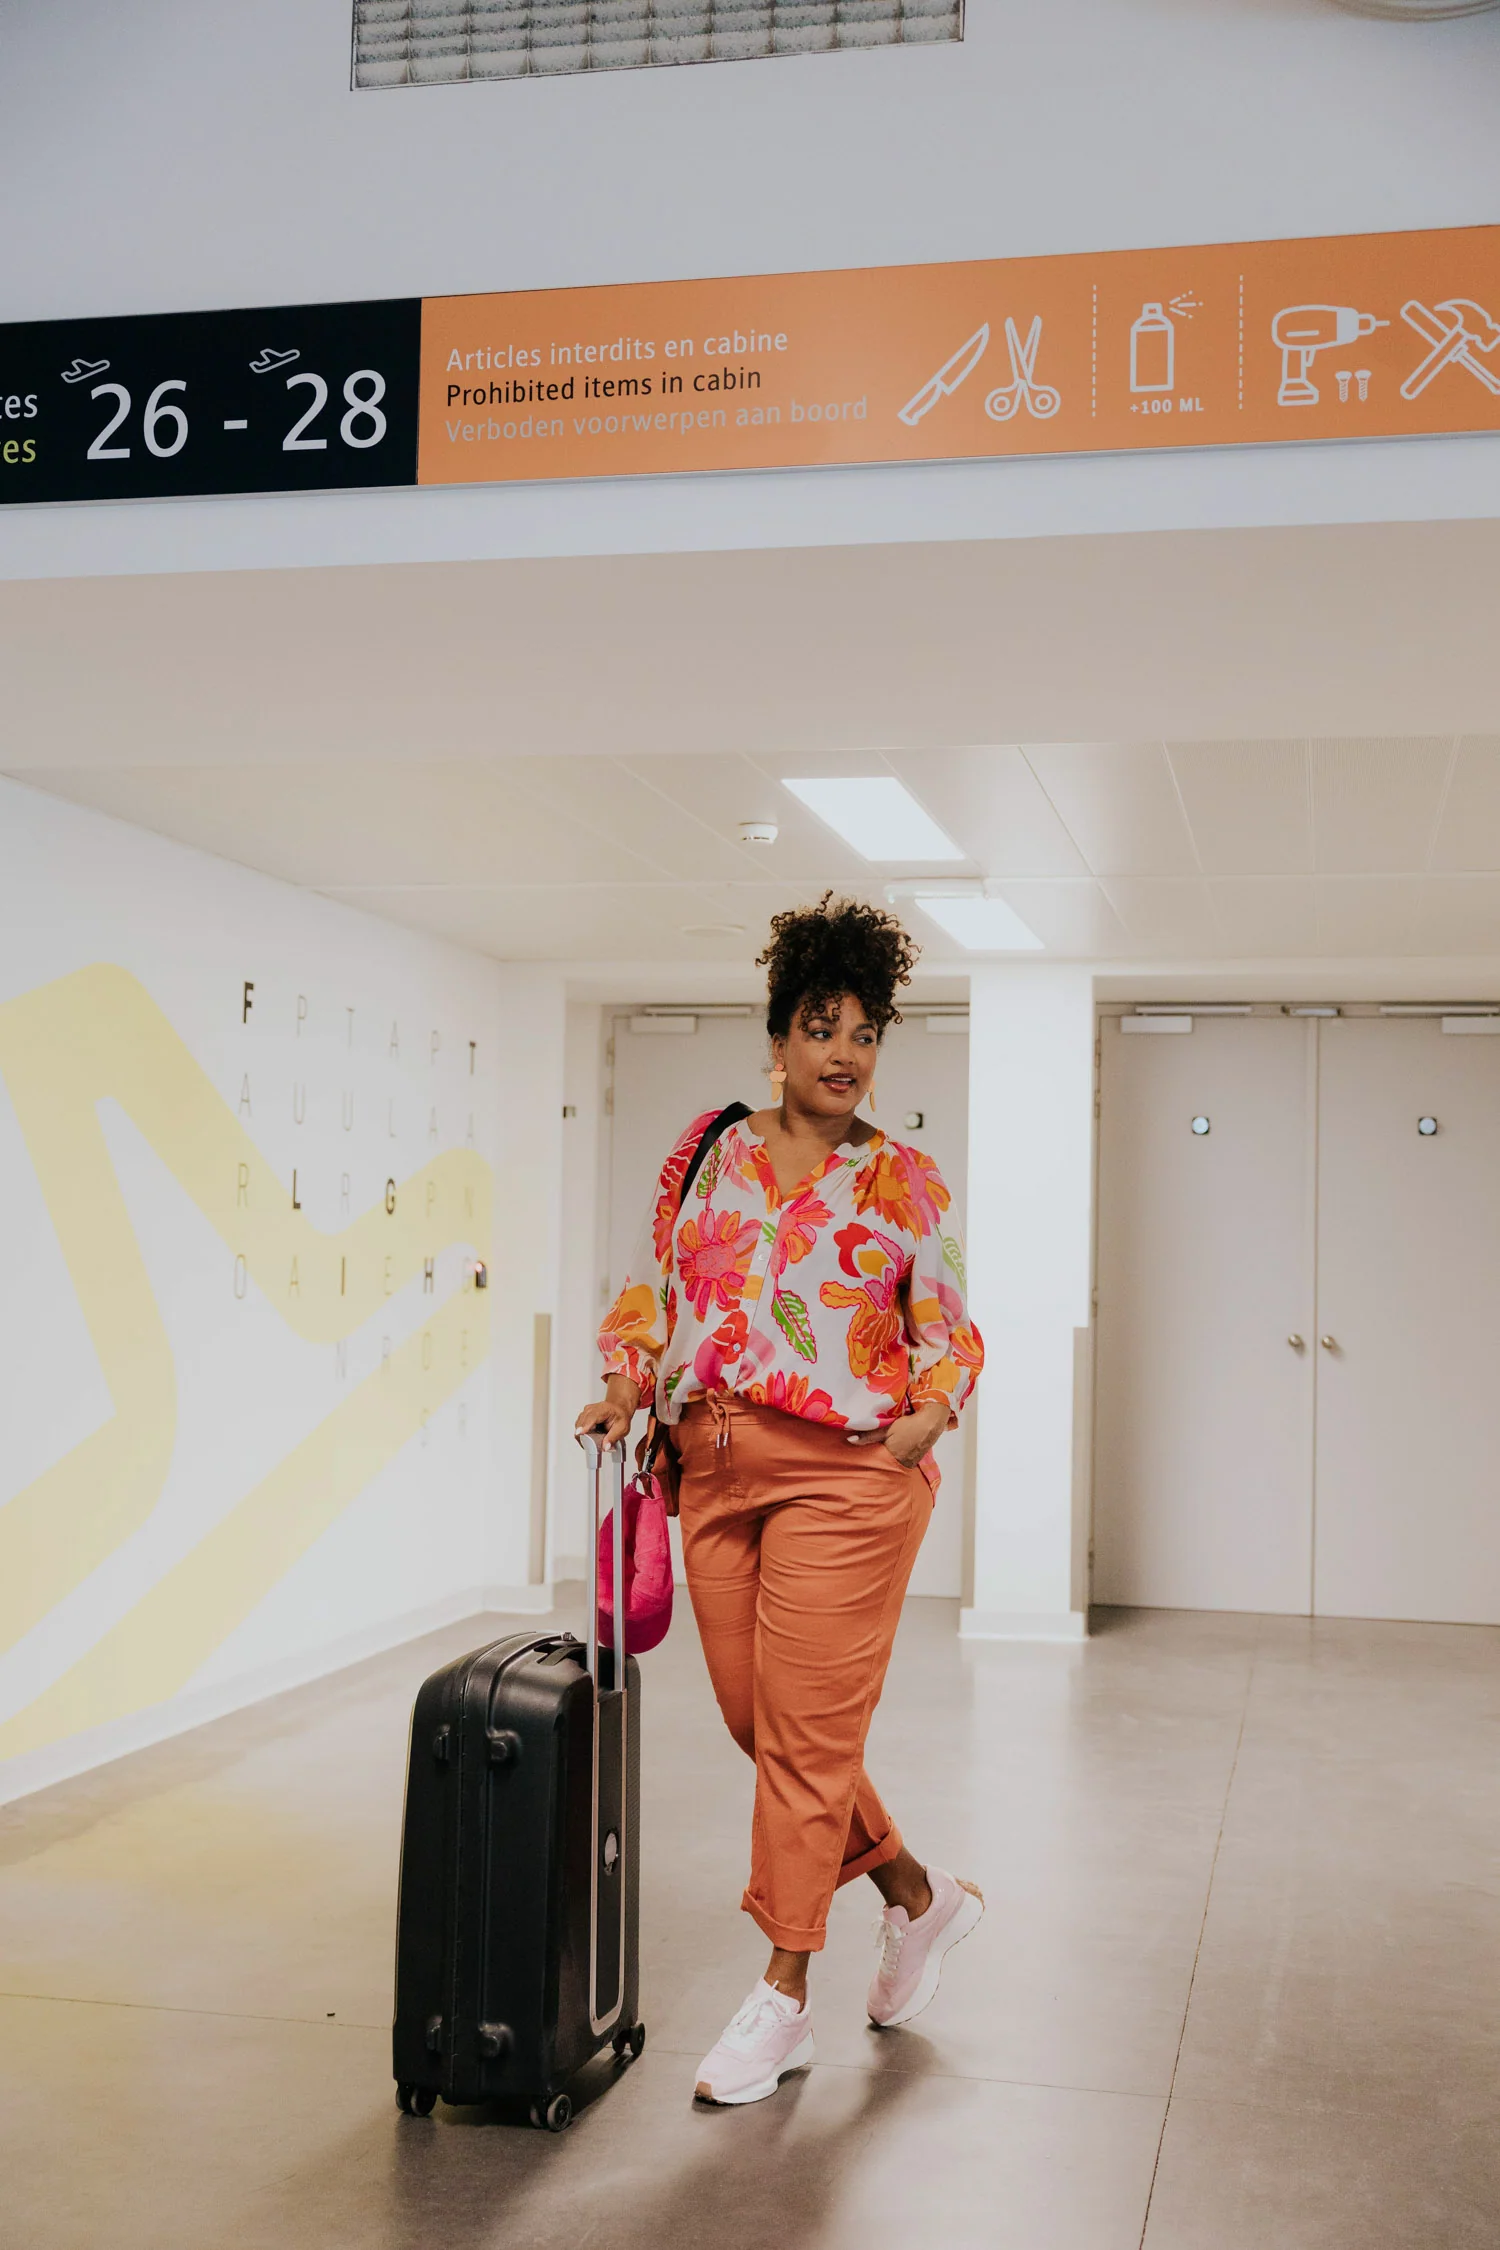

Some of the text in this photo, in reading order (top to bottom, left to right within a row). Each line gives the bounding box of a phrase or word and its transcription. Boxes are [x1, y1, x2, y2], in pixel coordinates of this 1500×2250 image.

[446, 329, 789, 371] Articles interdits en cabine
[0, 394, 38, 419] es
[447, 366, 762, 407] Prohibited items in cabin
[1130, 397, 1204, 414] +100 ML
[86, 369, 388, 459] 26 - 28
[446, 396, 868, 443] Verboden voorwerpen aan boord
[0, 439, 36, 463] es
